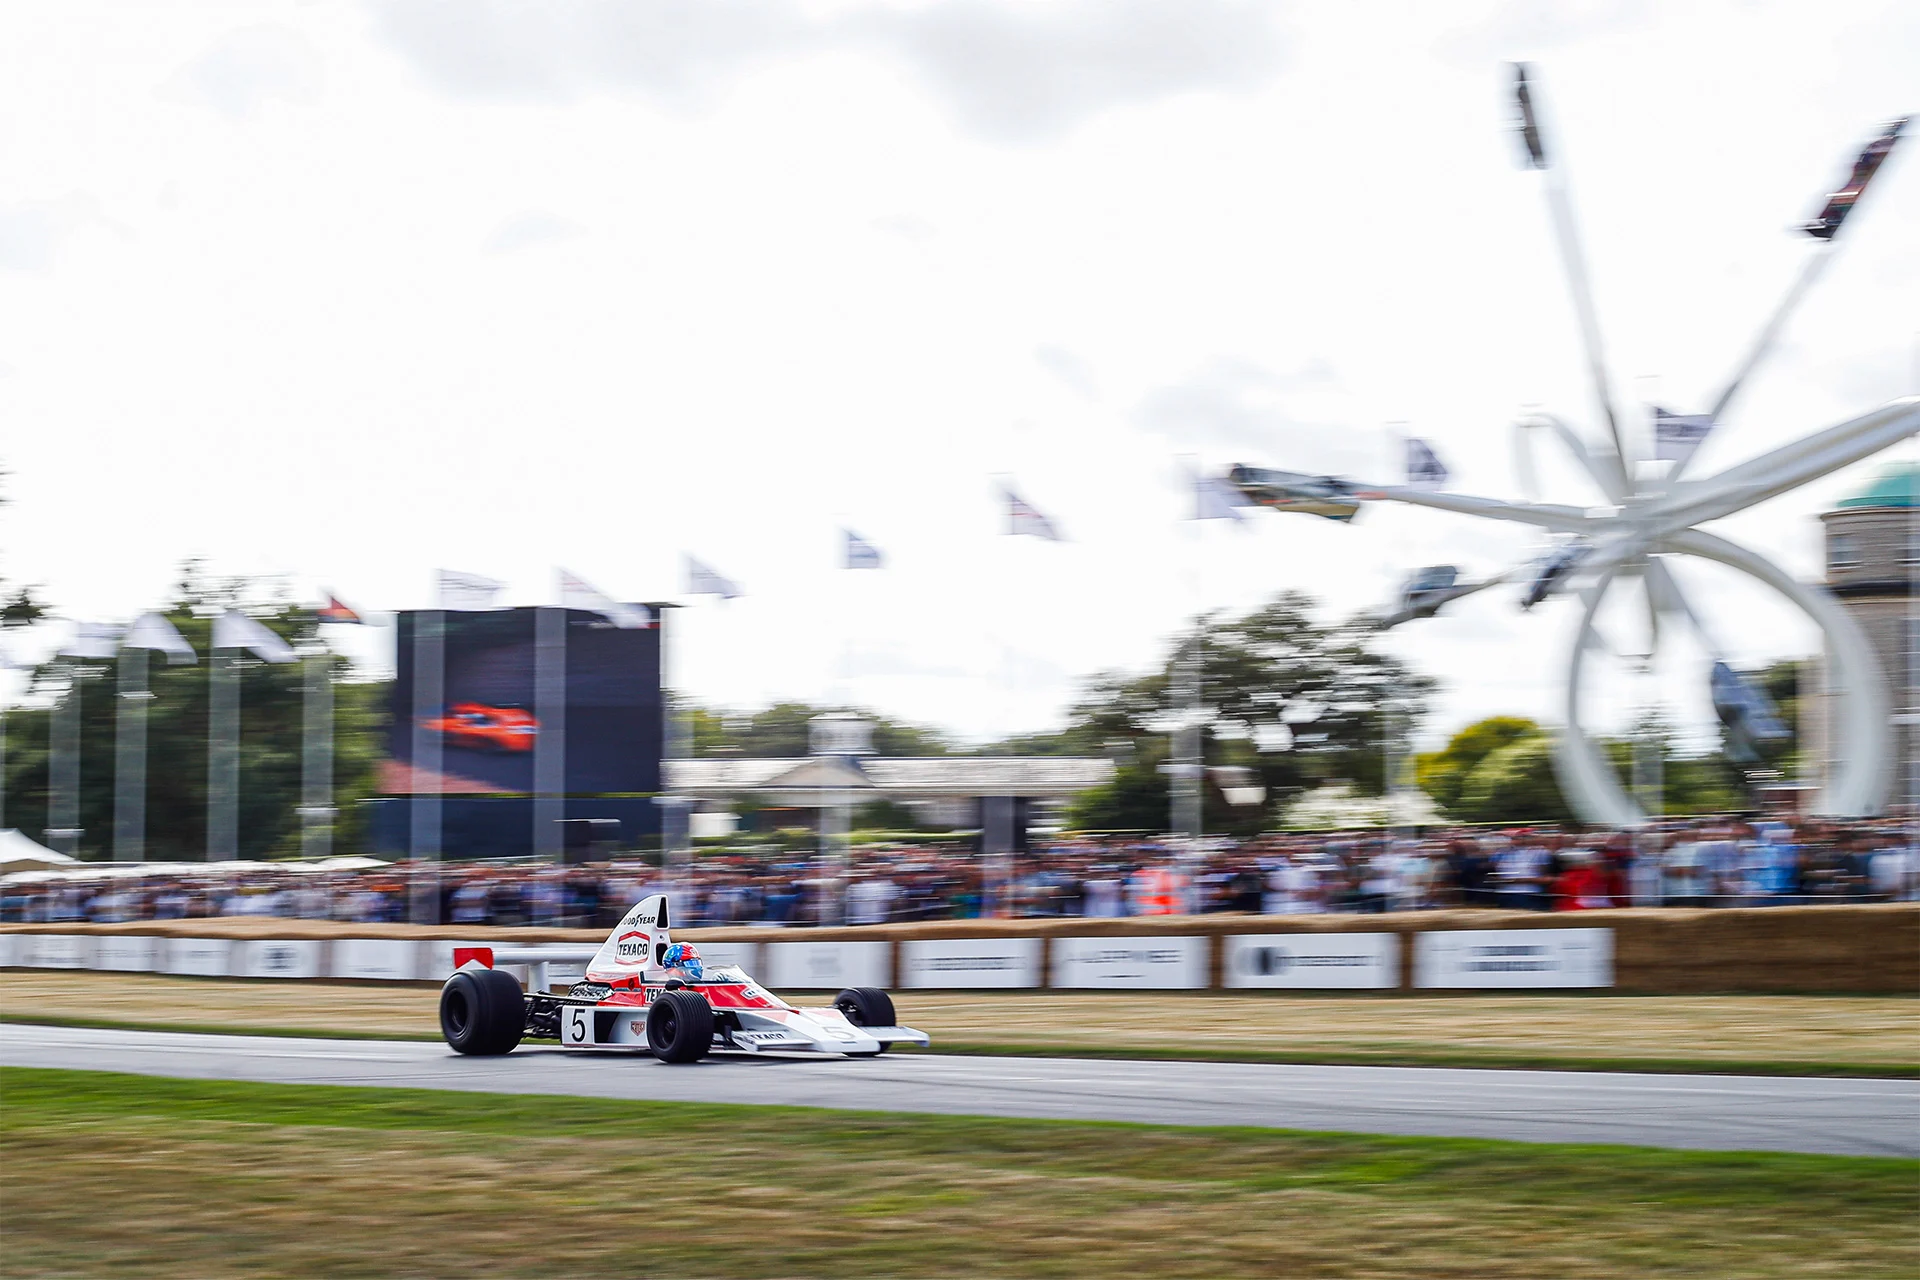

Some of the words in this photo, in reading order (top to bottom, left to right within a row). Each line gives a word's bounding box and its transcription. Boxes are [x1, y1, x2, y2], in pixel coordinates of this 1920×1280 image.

[618, 943, 648, 956] TEXACO
[645, 988, 667, 1002] TEX
[571, 1008, 586, 1042] 5
[822, 1026, 855, 1040] 5
